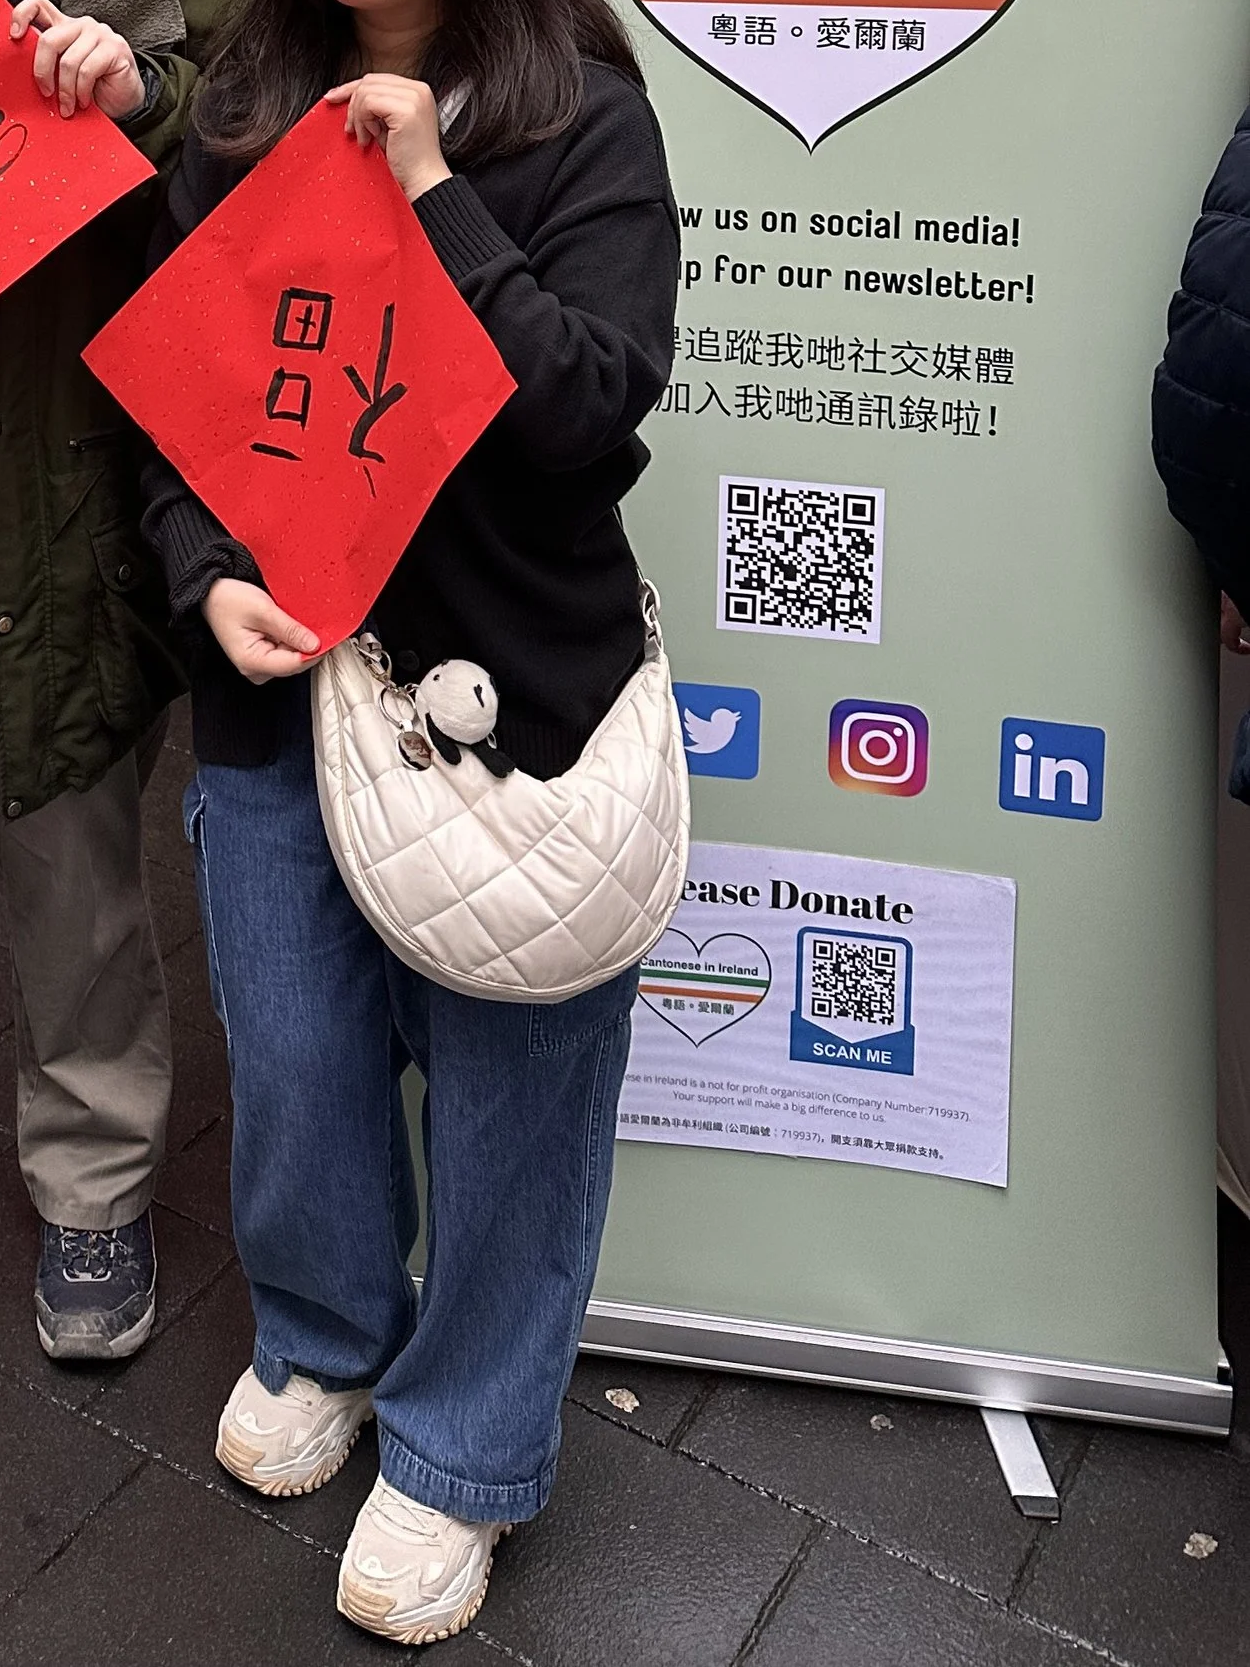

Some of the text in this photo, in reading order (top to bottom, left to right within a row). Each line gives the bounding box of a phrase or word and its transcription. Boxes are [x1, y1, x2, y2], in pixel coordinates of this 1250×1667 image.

[715, 208, 748, 231] us
[761, 211, 797, 233] on
[809, 209, 901, 239] social
[915, 217, 1020, 247] media!
[714, 254, 766, 285] for
[778, 265, 832, 289] our
[844, 267, 1035, 303] newsletter!
[250, 287, 408, 498] 福
[1013, 734, 1088, 805] in
[680, 879, 914, 924] ease Donate
[640, 956, 759, 977] Cantonese in Ireland
[813, 1042, 892, 1065] SCAN ME
[643, 1075, 653, 1084] in
[655, 1075, 688, 1087] Ireland
[690, 1078, 698, 1088] is
[700, 1080, 706, 1088] a
[708, 1081, 724, 1091] not
[726, 1082, 740, 1092] for
[742, 1084, 768, 1096] profit
[770, 1085, 831, 1102] organisation
[832, 1093, 882, 1110] (Company
[672, 1091, 695, 1102] Your
[697, 1093, 735, 1106] support
[738, 1097, 752, 1107] will
[754, 1098, 781, 1110] make
[783, 1102, 789, 1111] a
[791, 1103, 806, 1115] big
[808, 1103, 857, 1119] difference
[859, 1111, 870, 1121] to
